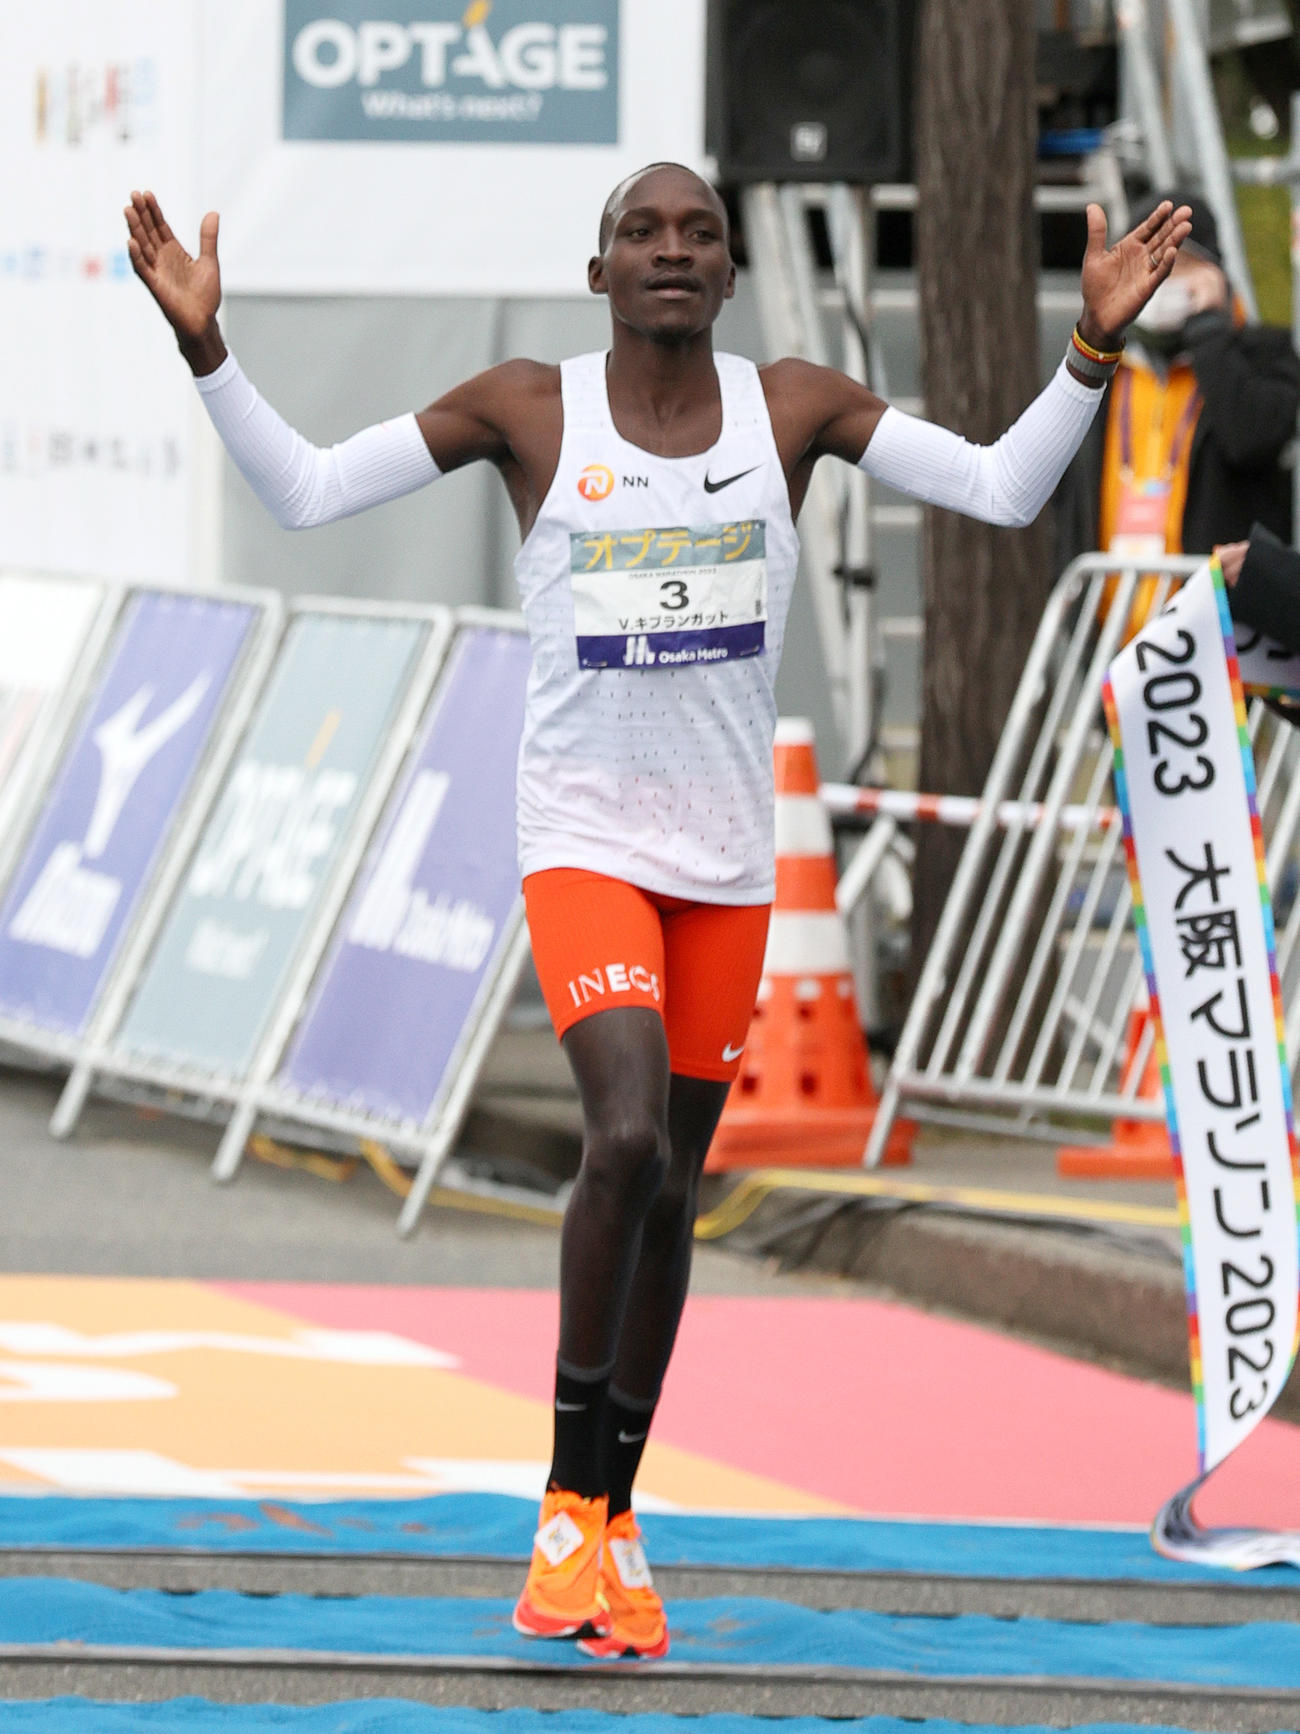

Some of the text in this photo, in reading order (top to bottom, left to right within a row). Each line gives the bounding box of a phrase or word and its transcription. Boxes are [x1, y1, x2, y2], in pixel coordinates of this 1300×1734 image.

[293, 18, 608, 90] OPTAGE
[622, 475, 649, 488] NN
[584, 523, 752, 570] オプテージ
[659, 580, 690, 611] 3
[659, 647, 729, 664] Osaka Metro
[1136, 606, 1216, 797] 2023
